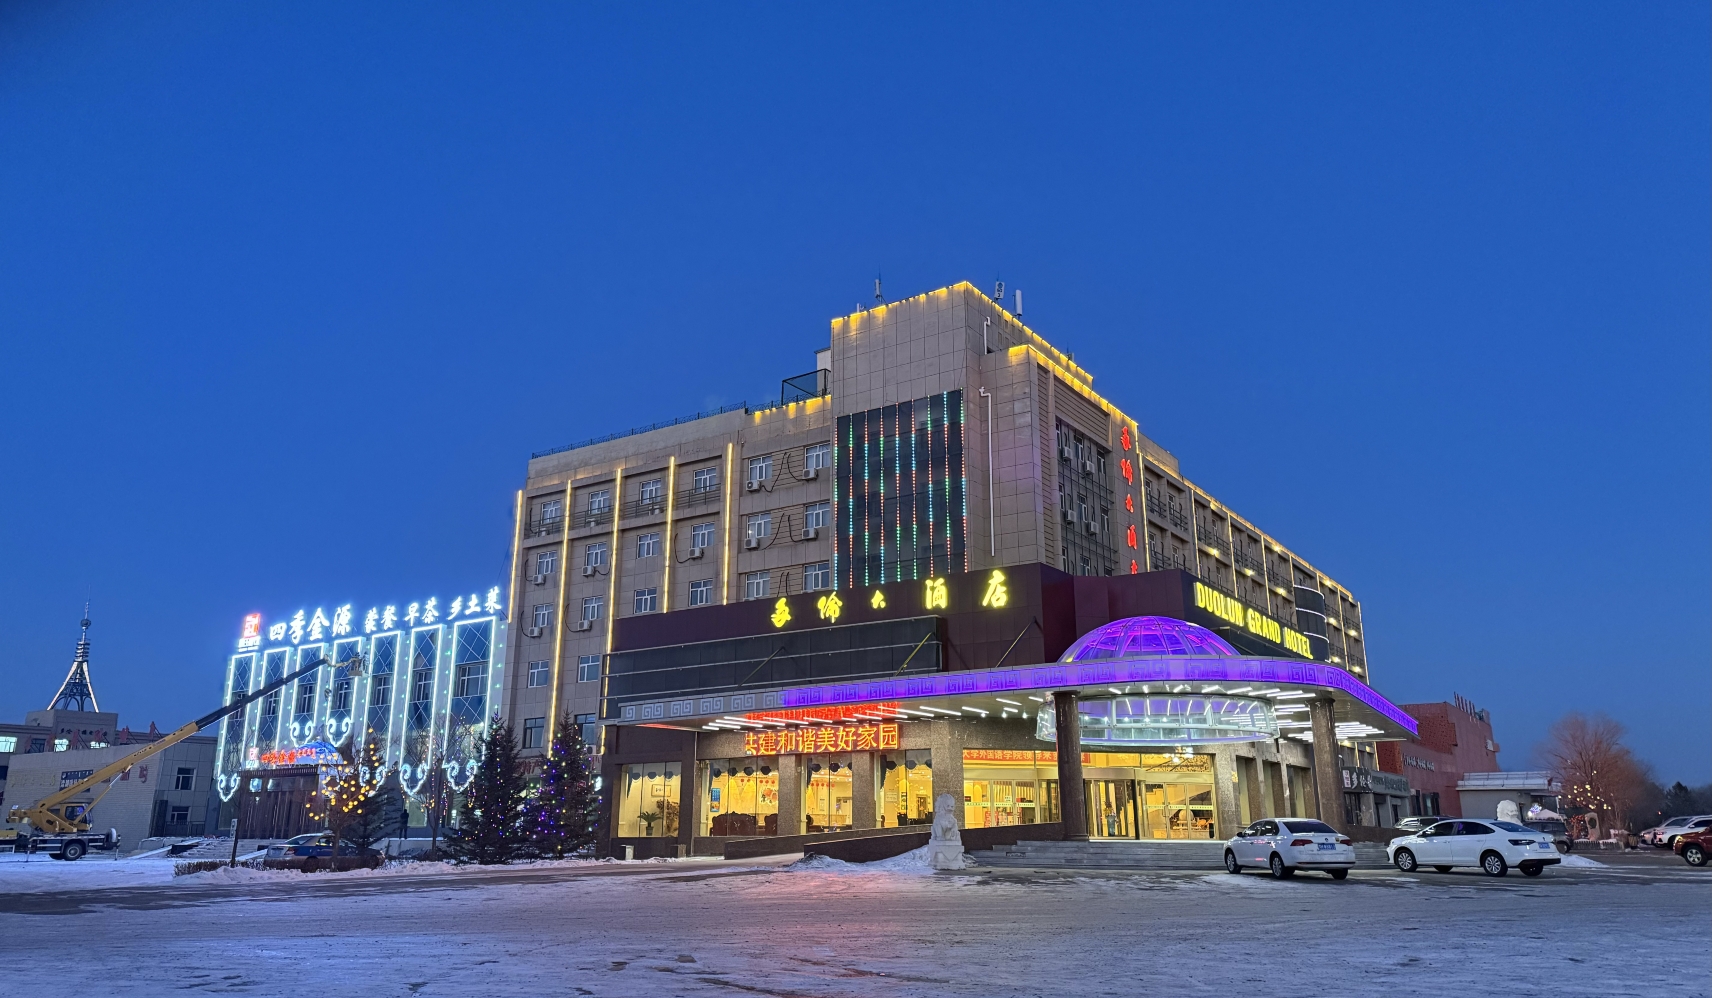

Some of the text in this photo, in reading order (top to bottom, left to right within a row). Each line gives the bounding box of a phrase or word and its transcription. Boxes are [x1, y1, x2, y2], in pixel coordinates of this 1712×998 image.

[404, 597, 439, 626] 早茶
[447, 585, 502, 620] 乡土菜
[1194, 581, 1314, 660] DUOLUN GRAND HOTEL
